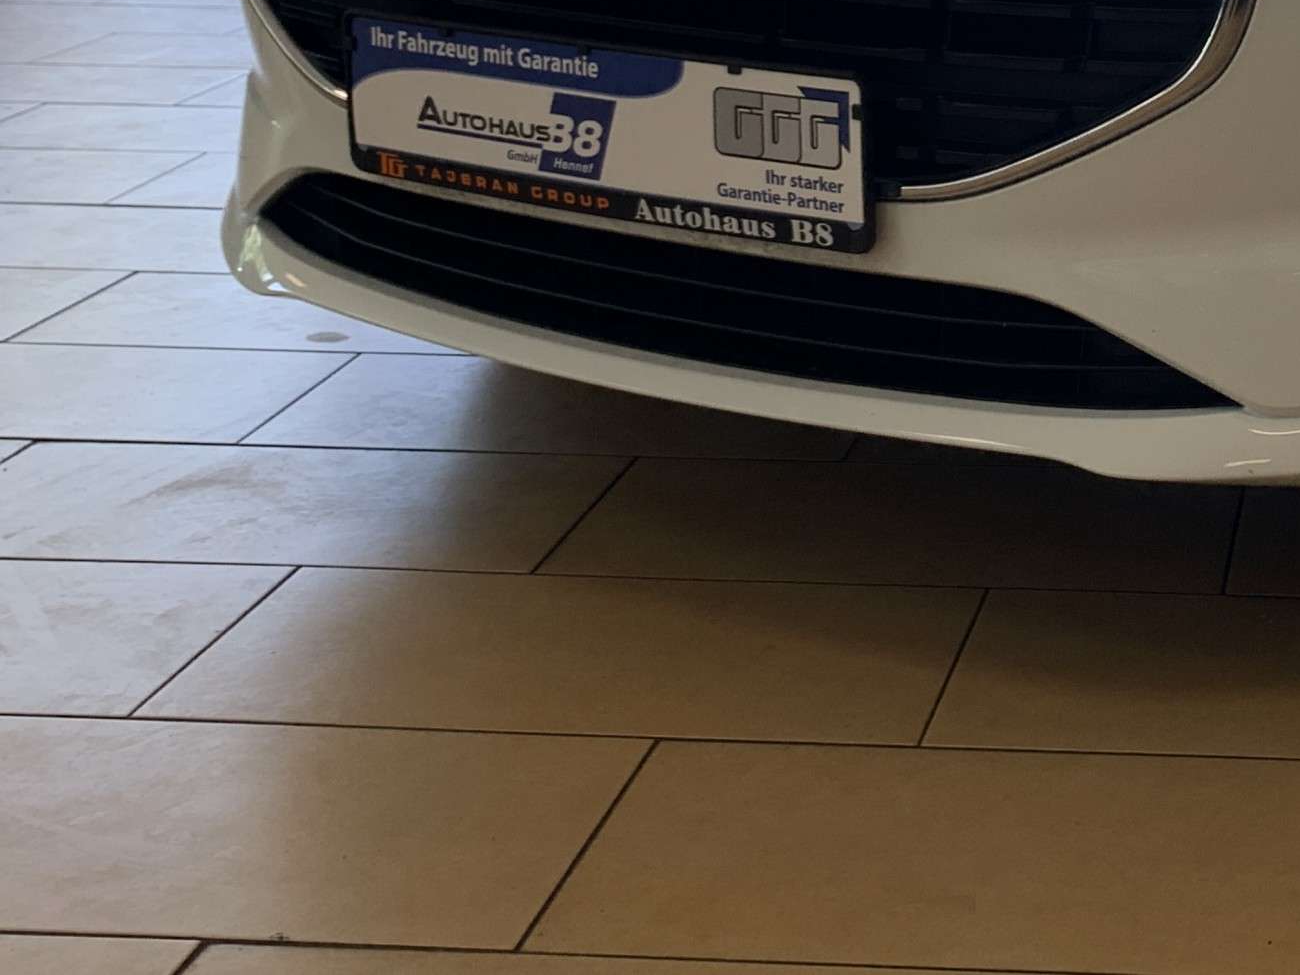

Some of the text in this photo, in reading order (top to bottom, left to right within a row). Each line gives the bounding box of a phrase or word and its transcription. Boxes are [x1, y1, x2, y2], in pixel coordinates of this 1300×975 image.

[369, 26, 599, 78] Ihr Fahrzeug mit Garantie
[506, 149, 595, 174] GmbH Hennef
[765, 169, 844, 194] Ihr starker
[531, 185, 610, 210] GROUP
[717, 182, 845, 214] Garantie-Partner
[635, 198, 834, 248] Autohaus B8
